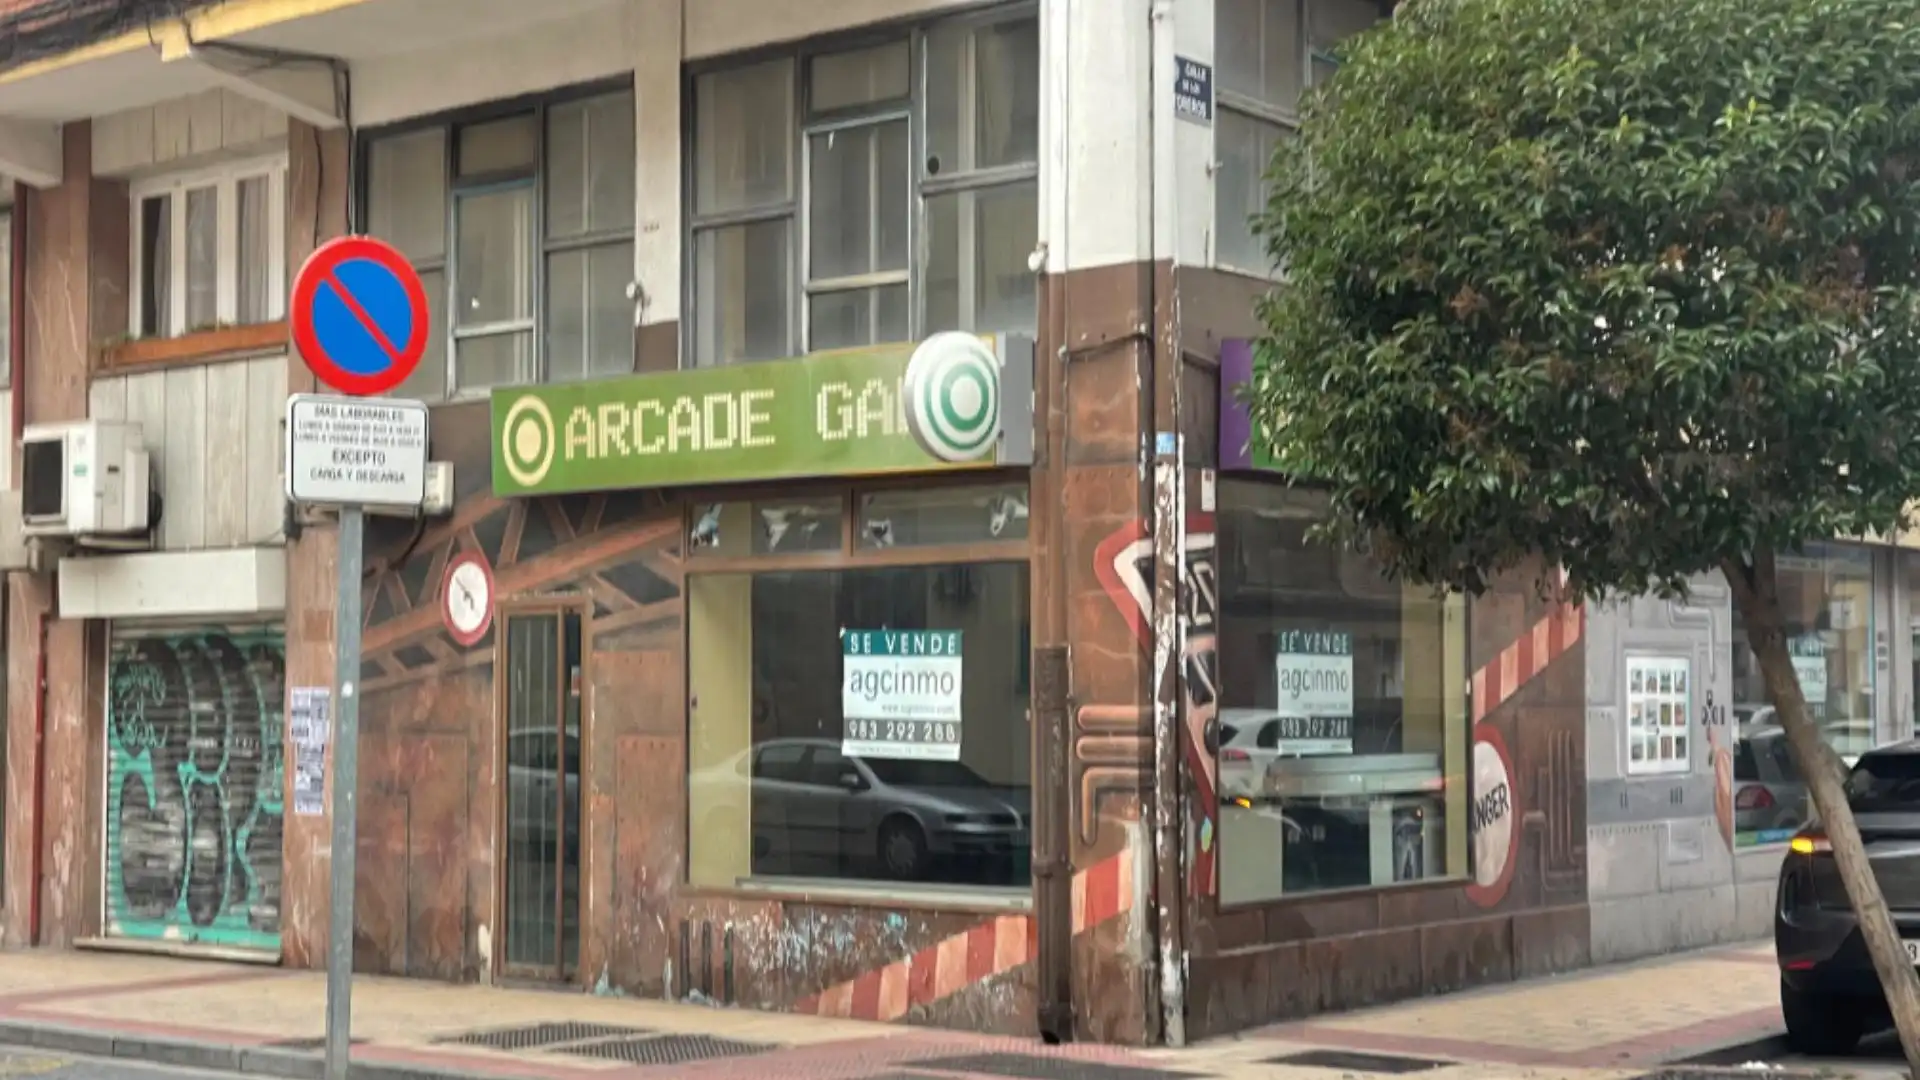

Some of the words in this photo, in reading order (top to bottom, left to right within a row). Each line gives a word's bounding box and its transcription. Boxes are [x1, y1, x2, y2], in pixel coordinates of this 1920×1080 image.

[340, 406, 404, 422] LABORABLES
[565, 389, 775, 461] ARCADE
[817, 376, 908, 441] GA
[332, 449, 386, 466] EXCEPTO
[310, 468, 342, 482] CARGA
[356, 470, 406, 484] DESCARGA
[850, 632, 872, 654] SE
[885, 632, 956, 655] VENDE
[850, 661, 954, 701] agcinmo
[1281, 662, 1349, 700] agcinmo
[849, 719, 877, 740] 983
[886, 720, 916, 741] 292
